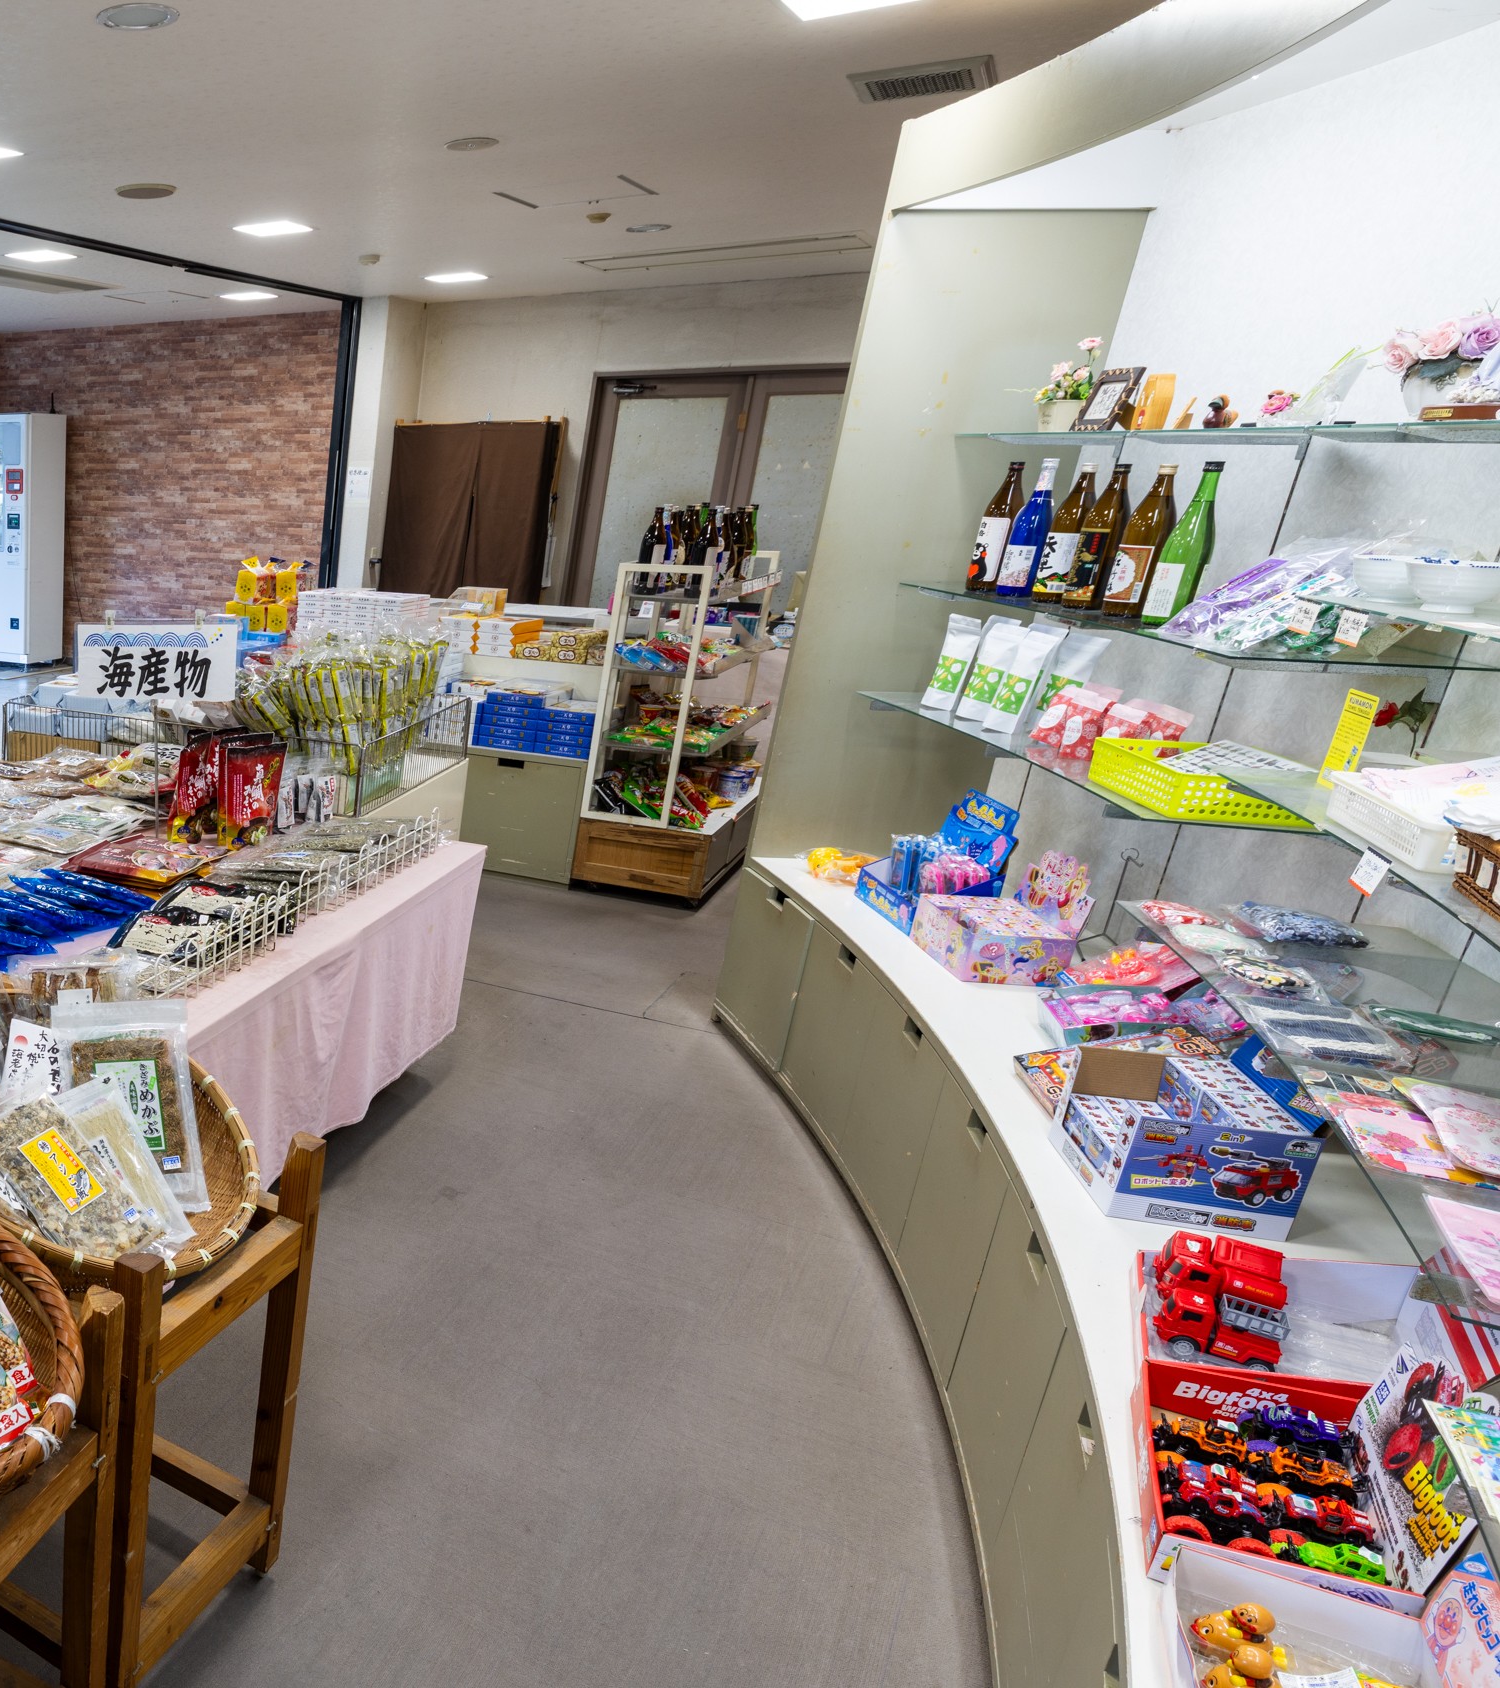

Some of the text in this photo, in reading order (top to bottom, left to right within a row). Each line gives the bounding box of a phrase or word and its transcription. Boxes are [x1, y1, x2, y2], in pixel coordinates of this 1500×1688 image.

[97, 646, 211, 698] 海産物
[138, 1063, 150, 1089] きざみ
[138, 1089, 160, 1136] めかぶ
[1133, 1177, 1194, 1187] ロボットに変身!
[1246, 1387, 1289, 1403] 4x4
[1364, 1398, 1377, 1425] POWER
[1402, 1459, 1461, 1549] Bigfoot
[1416, 1510, 1440, 1550] Wheel
